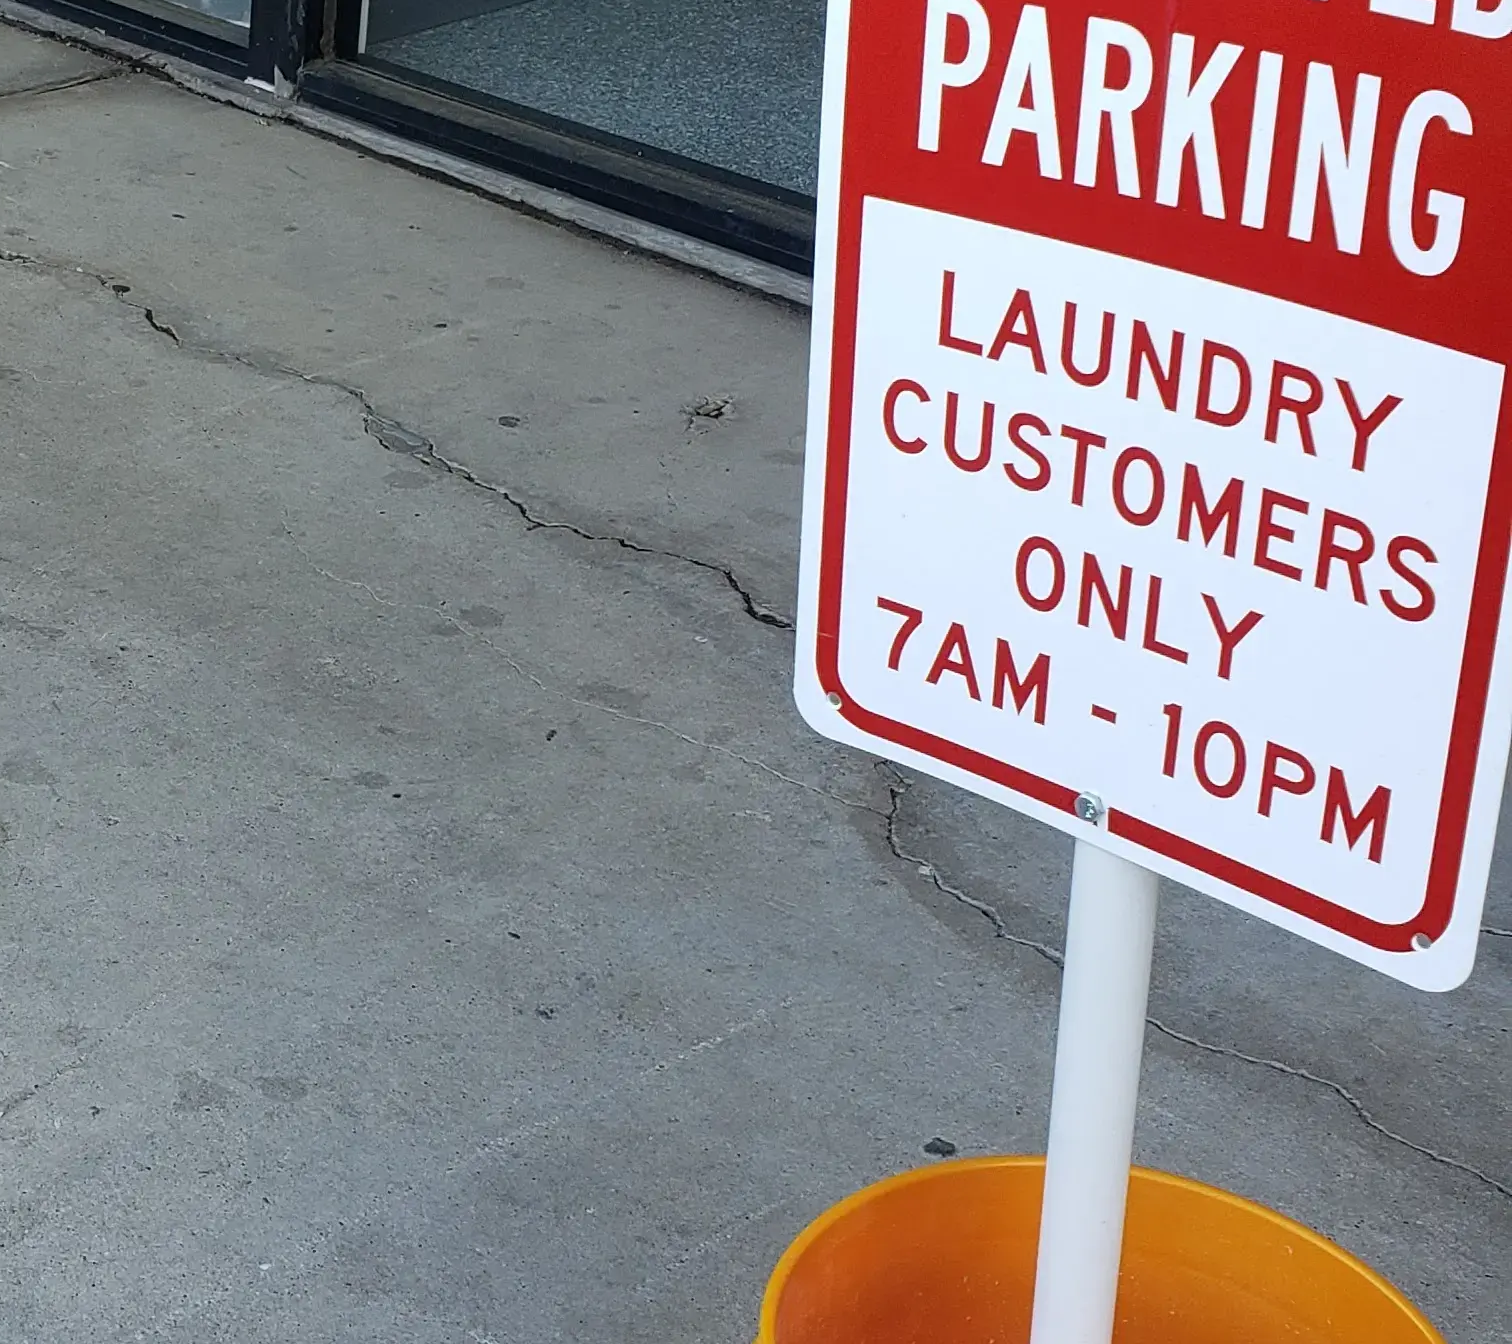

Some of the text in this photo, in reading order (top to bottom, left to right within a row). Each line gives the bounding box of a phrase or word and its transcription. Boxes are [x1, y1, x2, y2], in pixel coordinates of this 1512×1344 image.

[937, 269, 1404, 473] LAUNDRY
[883, 378, 1439, 622] CUSTOMERS
[1015, 536, 1265, 681] ONLY
[876, 596, 1052, 726] 7AM
[1159, 702, 1393, 865] 10PM
